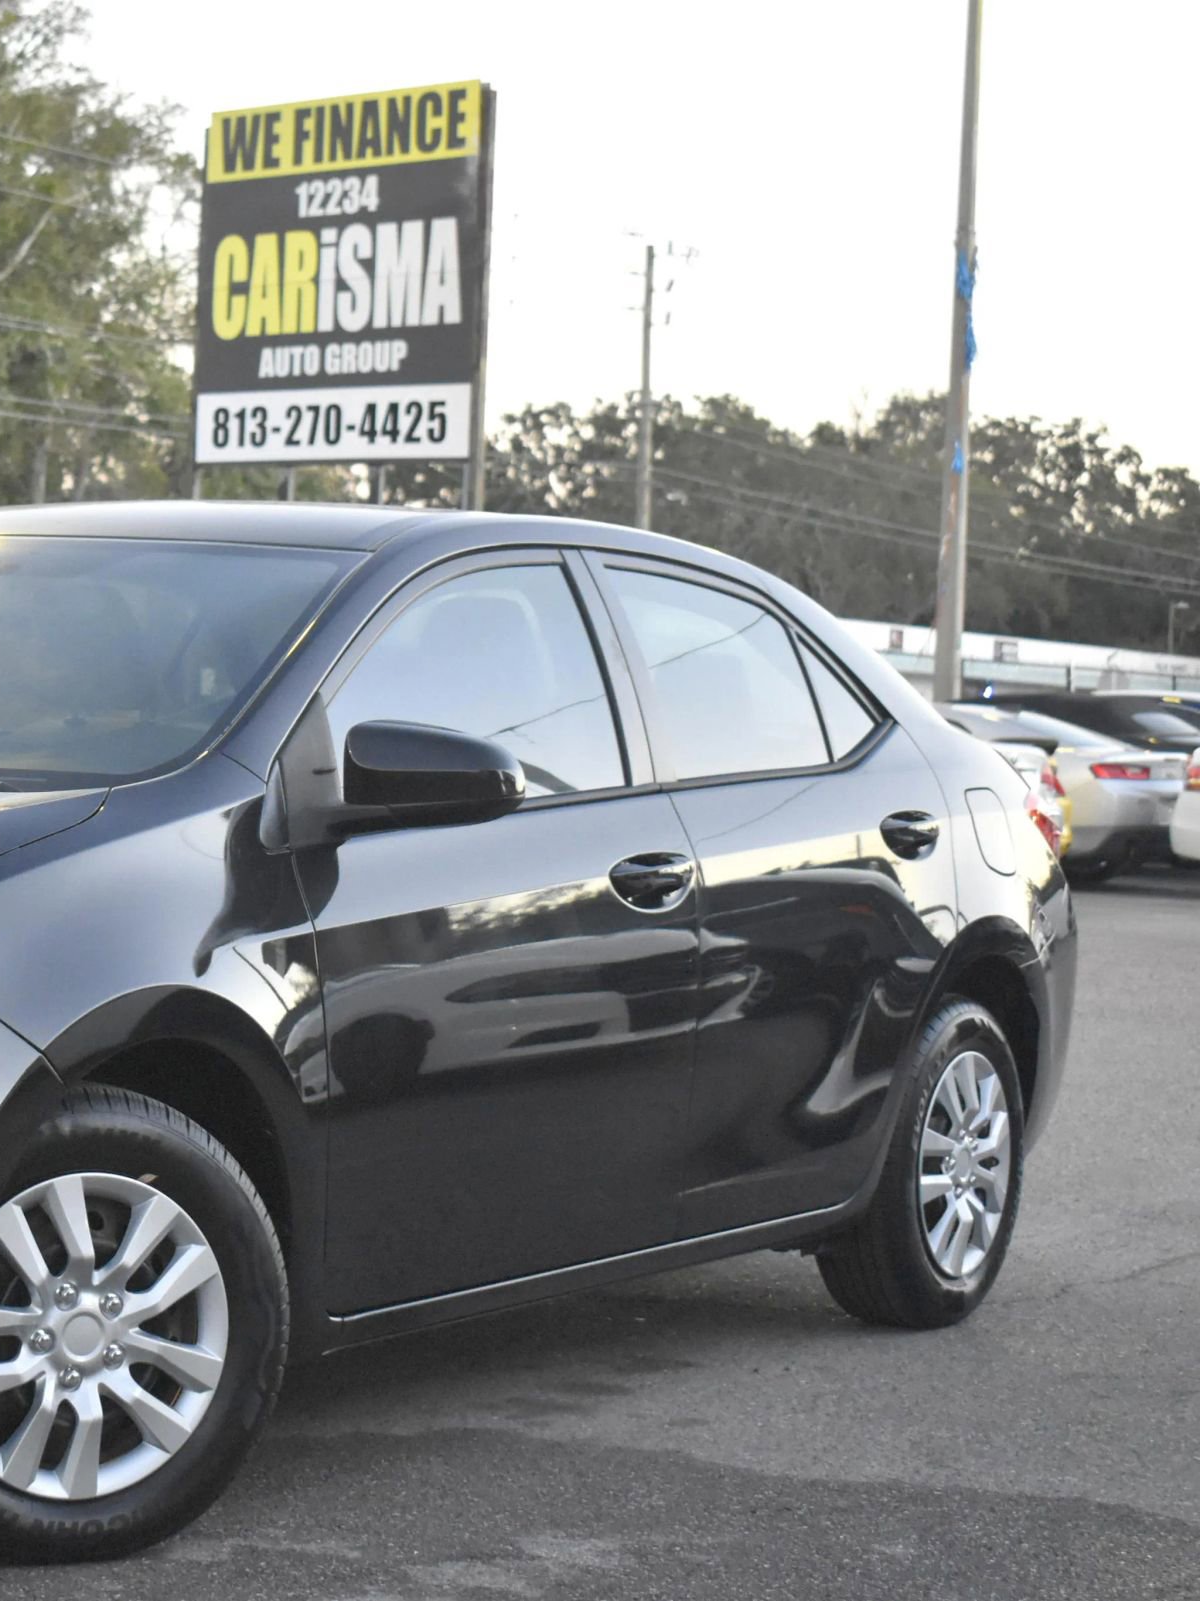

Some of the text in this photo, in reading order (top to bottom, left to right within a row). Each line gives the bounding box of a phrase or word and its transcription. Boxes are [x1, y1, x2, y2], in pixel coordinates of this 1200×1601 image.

[221, 87, 468, 174] WE FINANCE
[295, 174, 380, 218] 12234
[212, 217, 462, 340] CARiSMA
[258, 340, 408, 378] AUTO GROUP
[212, 401, 448, 449] 813-270-4425
